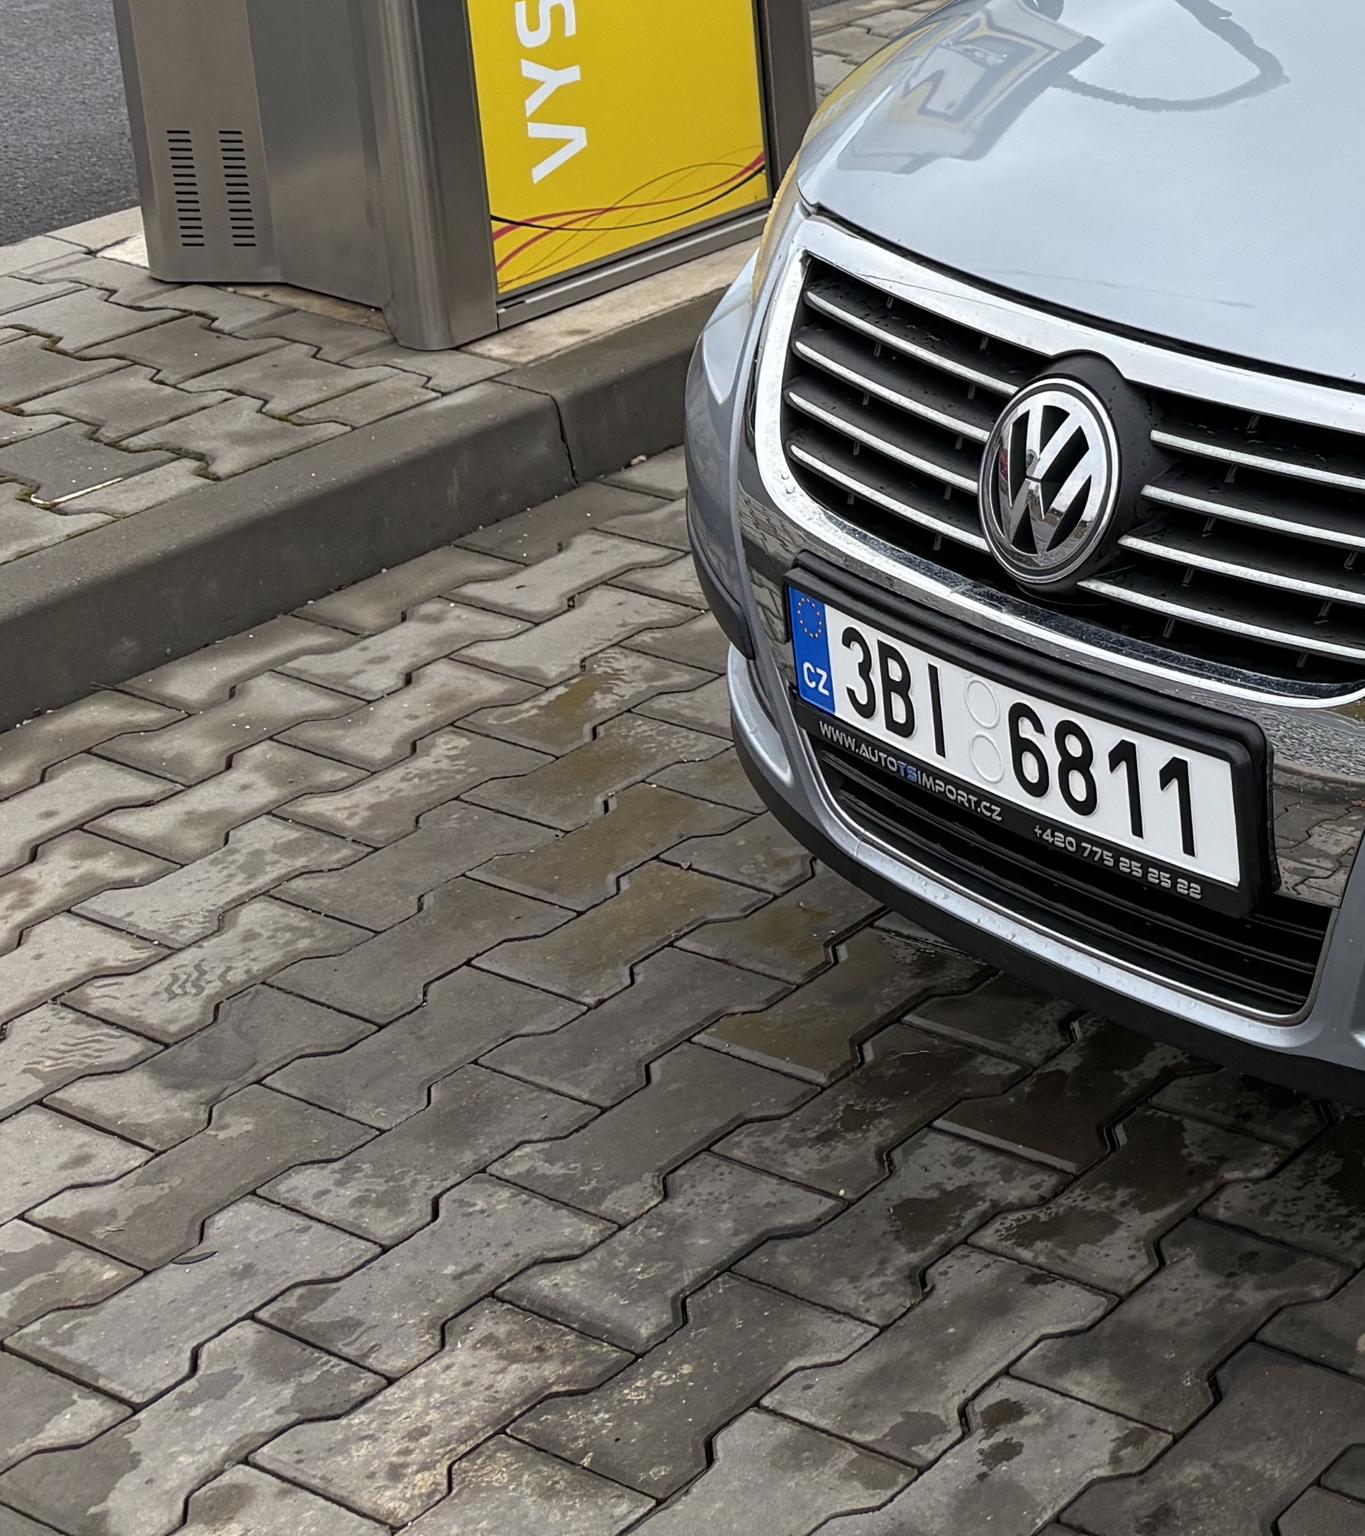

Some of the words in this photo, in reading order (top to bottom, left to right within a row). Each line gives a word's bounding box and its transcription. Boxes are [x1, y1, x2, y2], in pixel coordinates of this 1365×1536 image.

[803, 661, 829, 697] CZ
[842, 626, 946, 759] 3BI
[1008, 701, 1196, 859] 6811
[1034, 825, 1076, 852] +420
[1081, 842, 1114, 867] 775
[1119, 856, 1142, 878] 25
[1148, 867, 1171, 889] 25
[1176, 878, 1202, 900] 22
